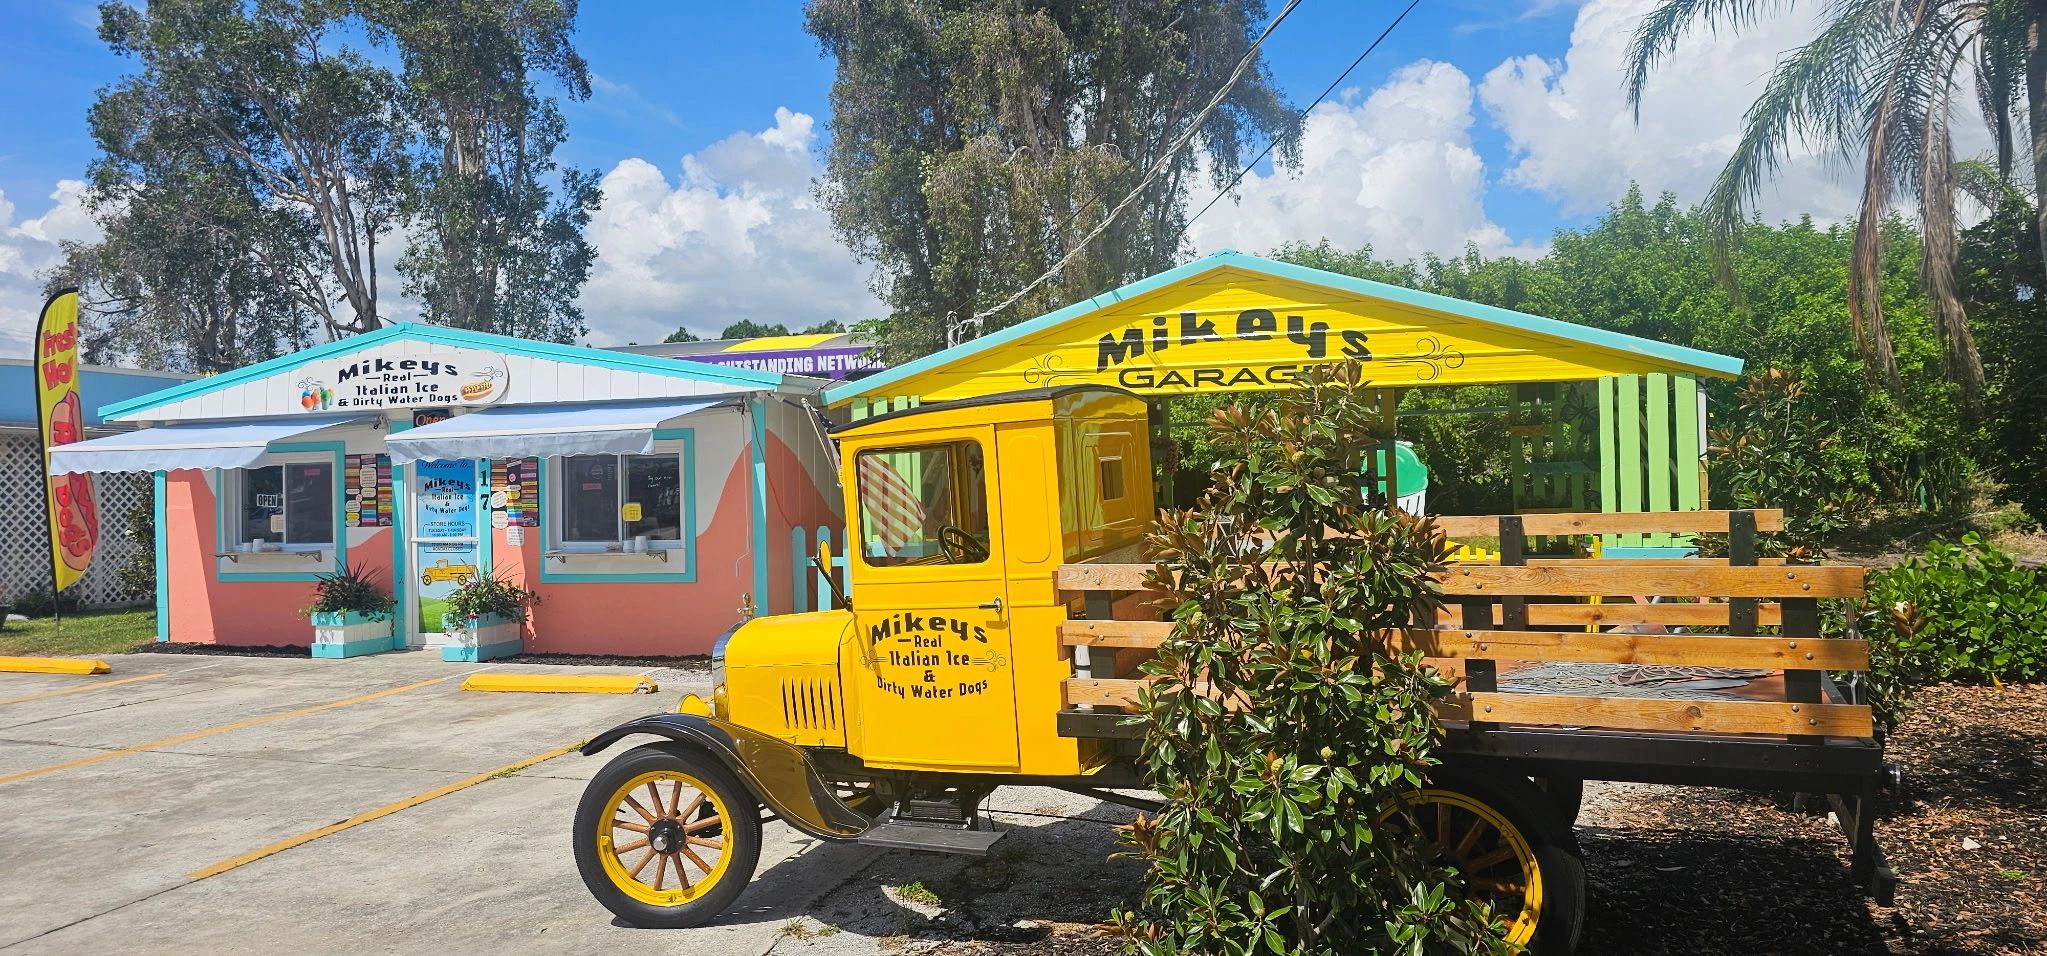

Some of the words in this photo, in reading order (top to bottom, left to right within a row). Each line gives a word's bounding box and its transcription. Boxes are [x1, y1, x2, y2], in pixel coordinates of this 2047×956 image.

[1097, 309, 1372, 373] Mikeys
[42, 355, 74, 391] Ho
[338, 358, 459, 384] Mikeys
[384, 372, 411, 383] Real
[356, 383, 409, 396] Italian
[416, 382, 439, 393] Ice
[338, 398, 349, 407] &
[353, 397, 383, 407] Dirty
[388, 395, 424, 405] Water
[430, 394, 458, 404] Dogs
[424, 478, 471, 492] Mikeys
[257, 494, 277, 507] OPEN
[871, 612, 988, 646] Mikeys
[914, 635, 942, 648] Real
[889, 650, 940, 667] Italian
[946, 650, 970, 666] Ice
[923, 670, 935, 683] &
[876, 675, 905, 699] Dirty
[911, 684, 953, 699] Water
[959, 679, 988, 696] Dogs
